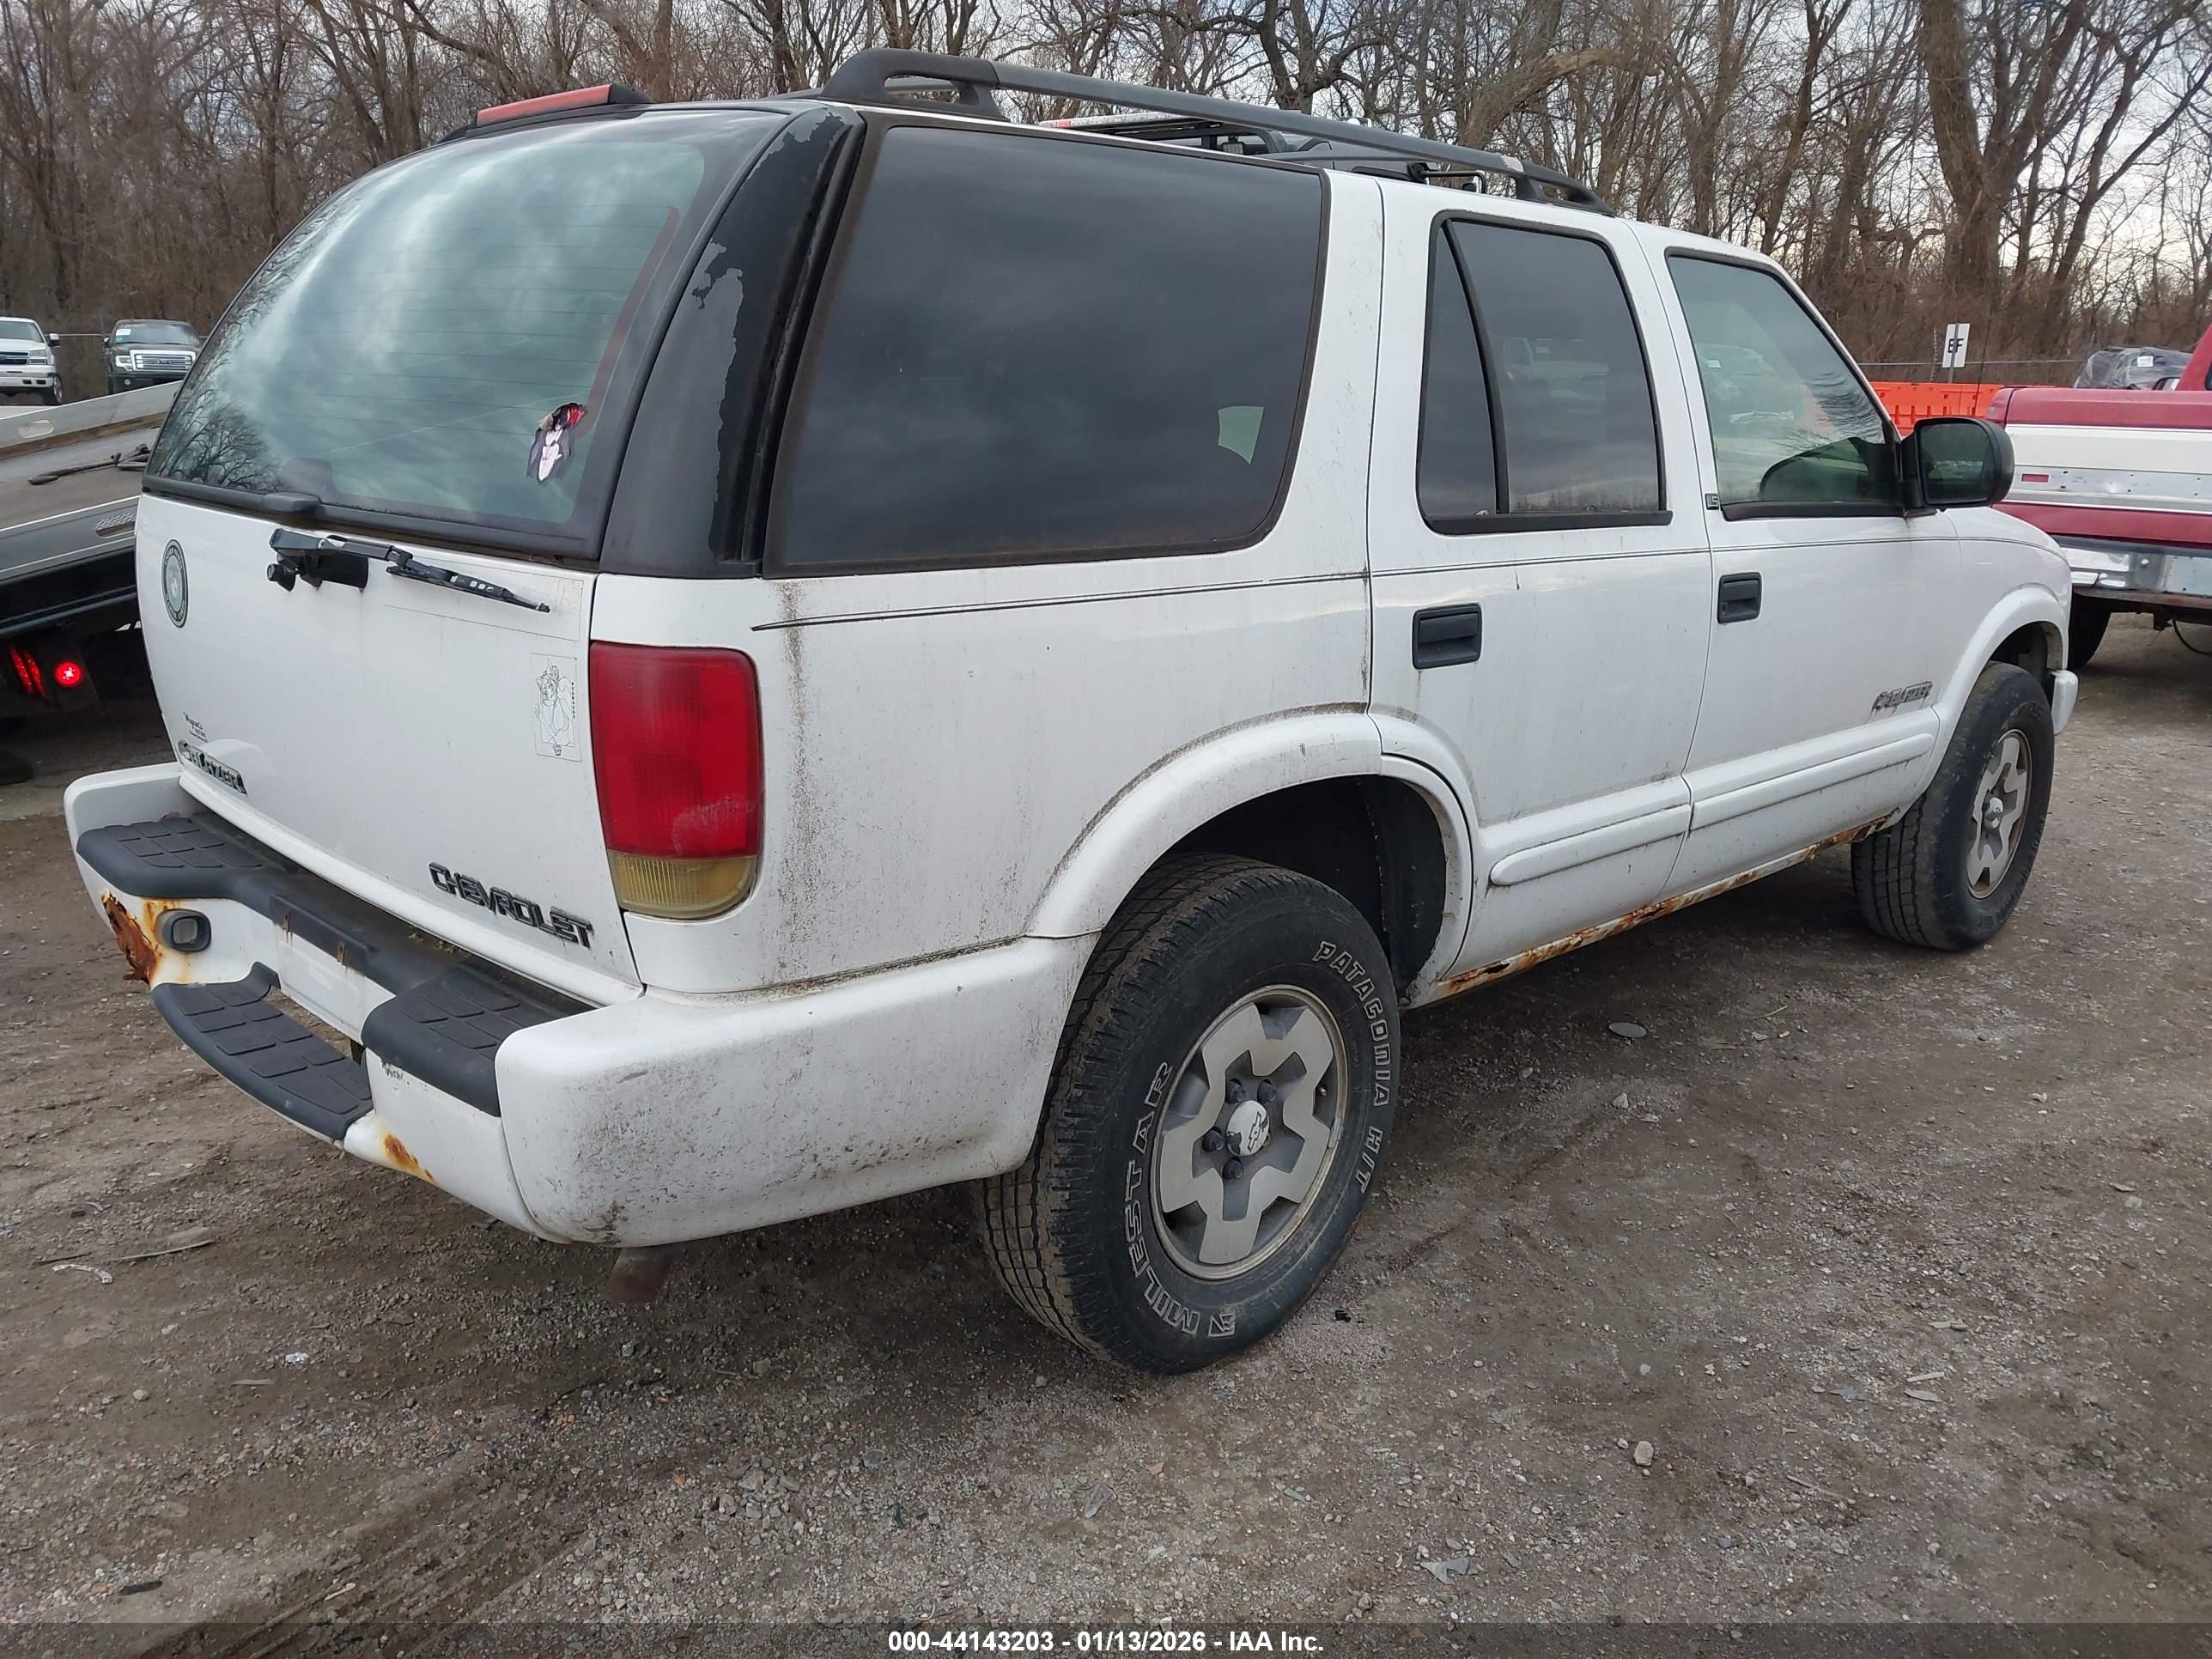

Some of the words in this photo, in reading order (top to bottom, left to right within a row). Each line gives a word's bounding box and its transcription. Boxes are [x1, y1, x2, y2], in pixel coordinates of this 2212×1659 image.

[428, 862, 594, 948] CHEVROLET
[1312, 941, 1391, 1106] PATAGONIA
[1356, 1126, 1383, 1194] H/T
[1125, 1062, 1200, 1334] MILESTAR
